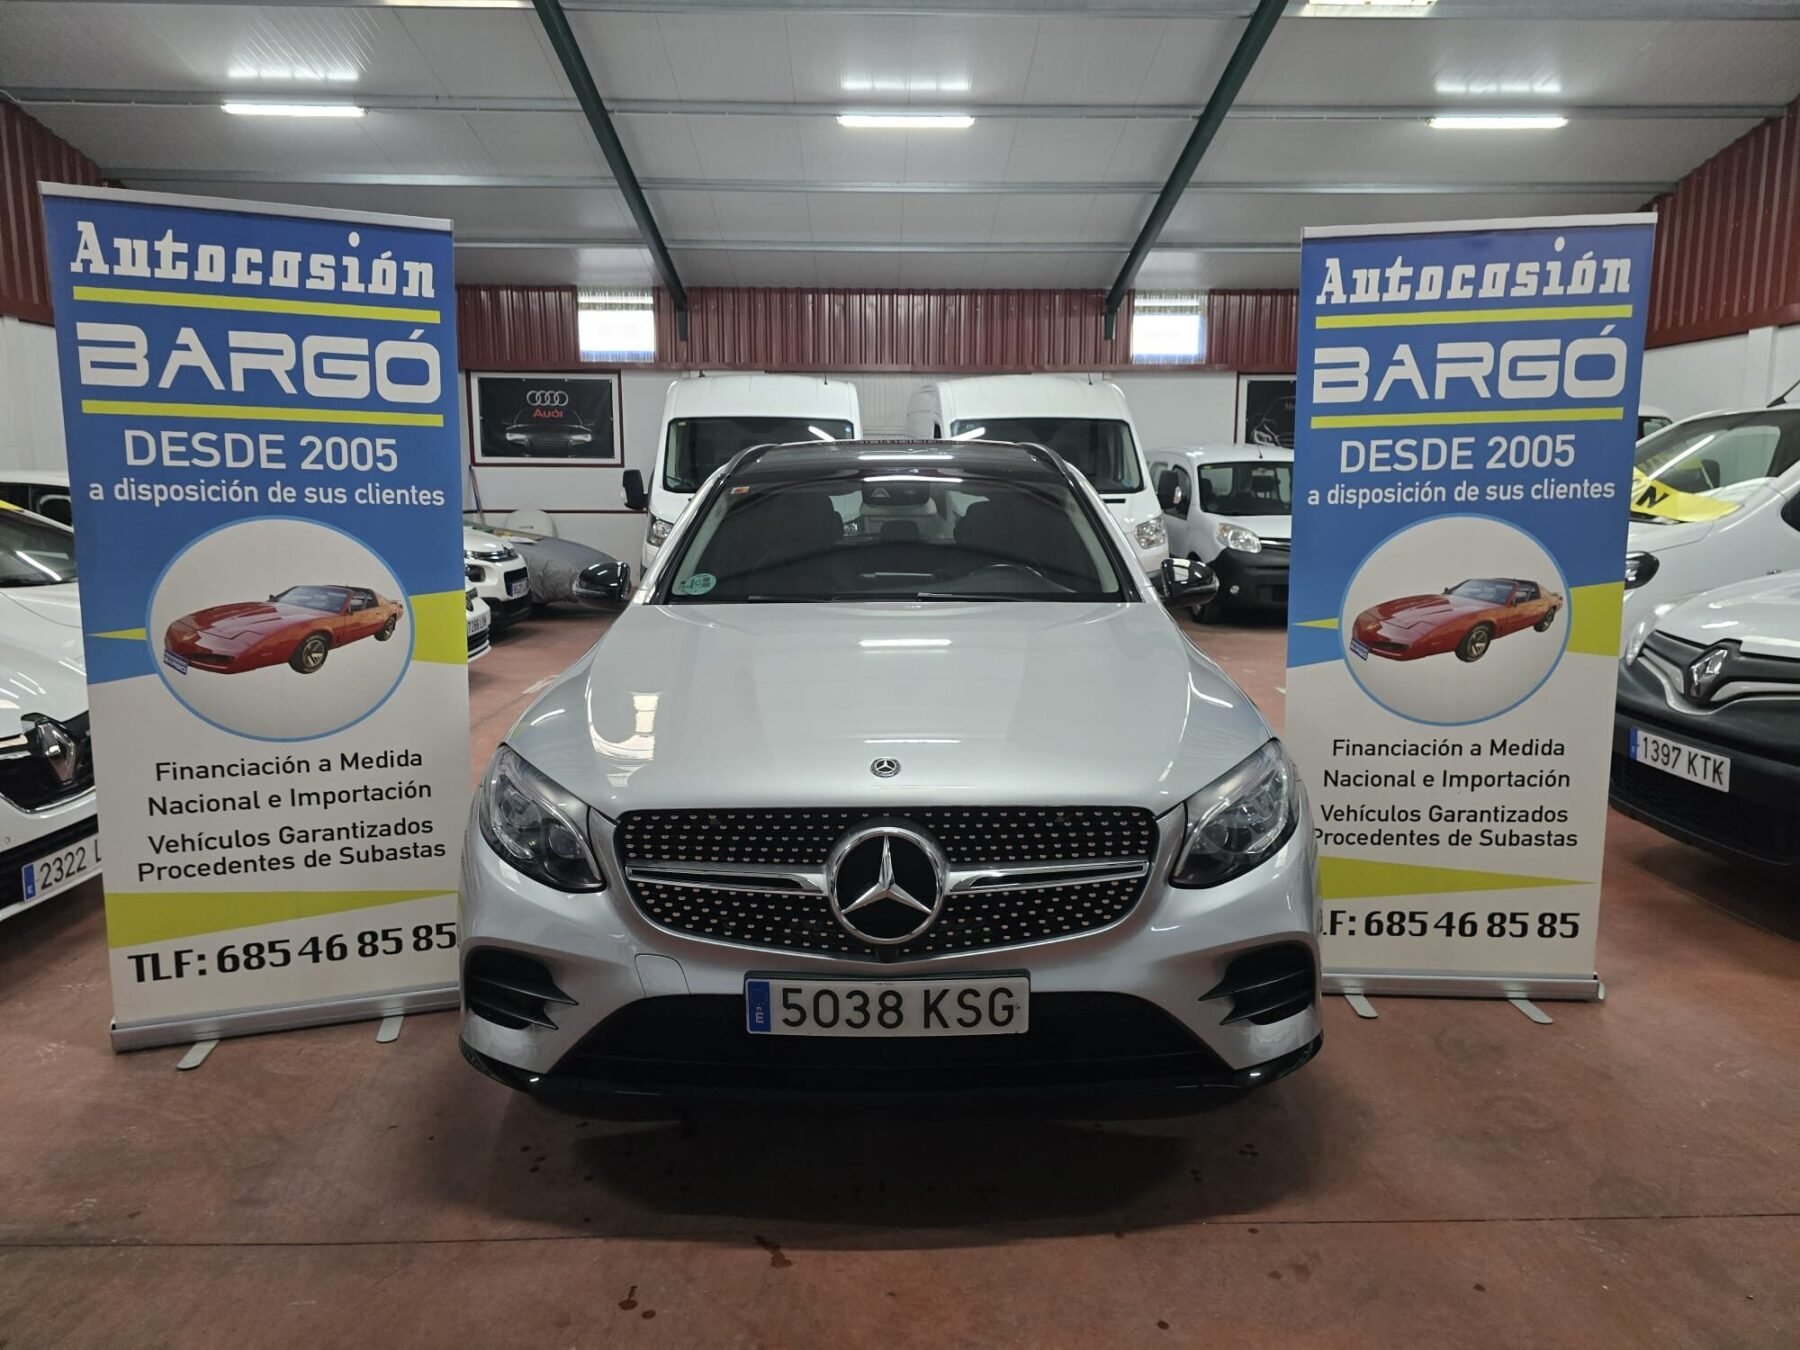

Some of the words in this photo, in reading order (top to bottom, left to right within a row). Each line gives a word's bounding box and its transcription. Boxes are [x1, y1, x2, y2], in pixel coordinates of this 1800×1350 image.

[70, 221, 435, 298] Autocasión
[1316, 236, 1631, 305] Autocasión
[76, 321, 442, 404] BARGÓ
[1312, 324, 1628, 404] BARGÓ
[533, 408, 563, 418] Audi
[124, 429, 287, 470] DESDE
[299, 435, 399, 473] 2005
[1339, 436, 1476, 474] DESDE
[1486, 434, 1576, 470] 2005
[88, 482, 105, 501] a
[114, 478, 259, 507] disposición
[268, 480, 298, 503] de
[304, 485, 347, 505] sus
[354, 482, 445, 506] clientes
[1307, 488, 1320, 505] a
[1327, 481, 1446, 510] disposición
[1454, 481, 1479, 502] de
[1486, 483, 1524, 501] sus
[1531, 478, 1616, 500] clientes
[155, 755, 311, 782] Financiación
[319, 757, 332, 773] a
[340, 749, 423, 772] Medida
[1332, 738, 1463, 757] Financiación
[1470, 742, 1482, 757] a
[1489, 738, 1566, 757] Medida
[1643, 736, 1682, 769] 1397
[1688, 751, 1725, 786] KTK
[148, 790, 260, 816] Nacional
[268, 793, 281, 809] e
[290, 780, 432, 810] Importación
[1323, 769, 1416, 788] Nacional
[1422, 773, 1435, 788] e
[1442, 769, 1571, 791] Importación
[1320, 804, 1421, 823] Vehículos
[1428, 804, 1569, 823] Garantizados
[147, 827, 271, 855] Vehículos
[278, 817, 434, 846] Garantizados
[1314, 828, 1441, 847] Procedentes
[1448, 828, 1474, 847] de
[1480, 828, 1578, 847] Subastas
[40, 846, 87, 890] 2322
[138, 855, 295, 882] Procedentes
[304, 850, 332, 869] de
[339, 841, 447, 864] Subastas
[1364, 910, 1429, 937] 685
[1433, 911, 1478, 938] 46
[1487, 911, 1530, 938] 85
[1537, 912, 1580, 939] 85
[128, 950, 207, 983] TLF:
[216, 939, 292, 974] 685
[297, 934, 348, 964] 46
[357, 927, 403, 958] 85
[411, 922, 457, 952] 85
[782, 988, 904, 1029] 5038
[923, 987, 1015, 1029] KSG
